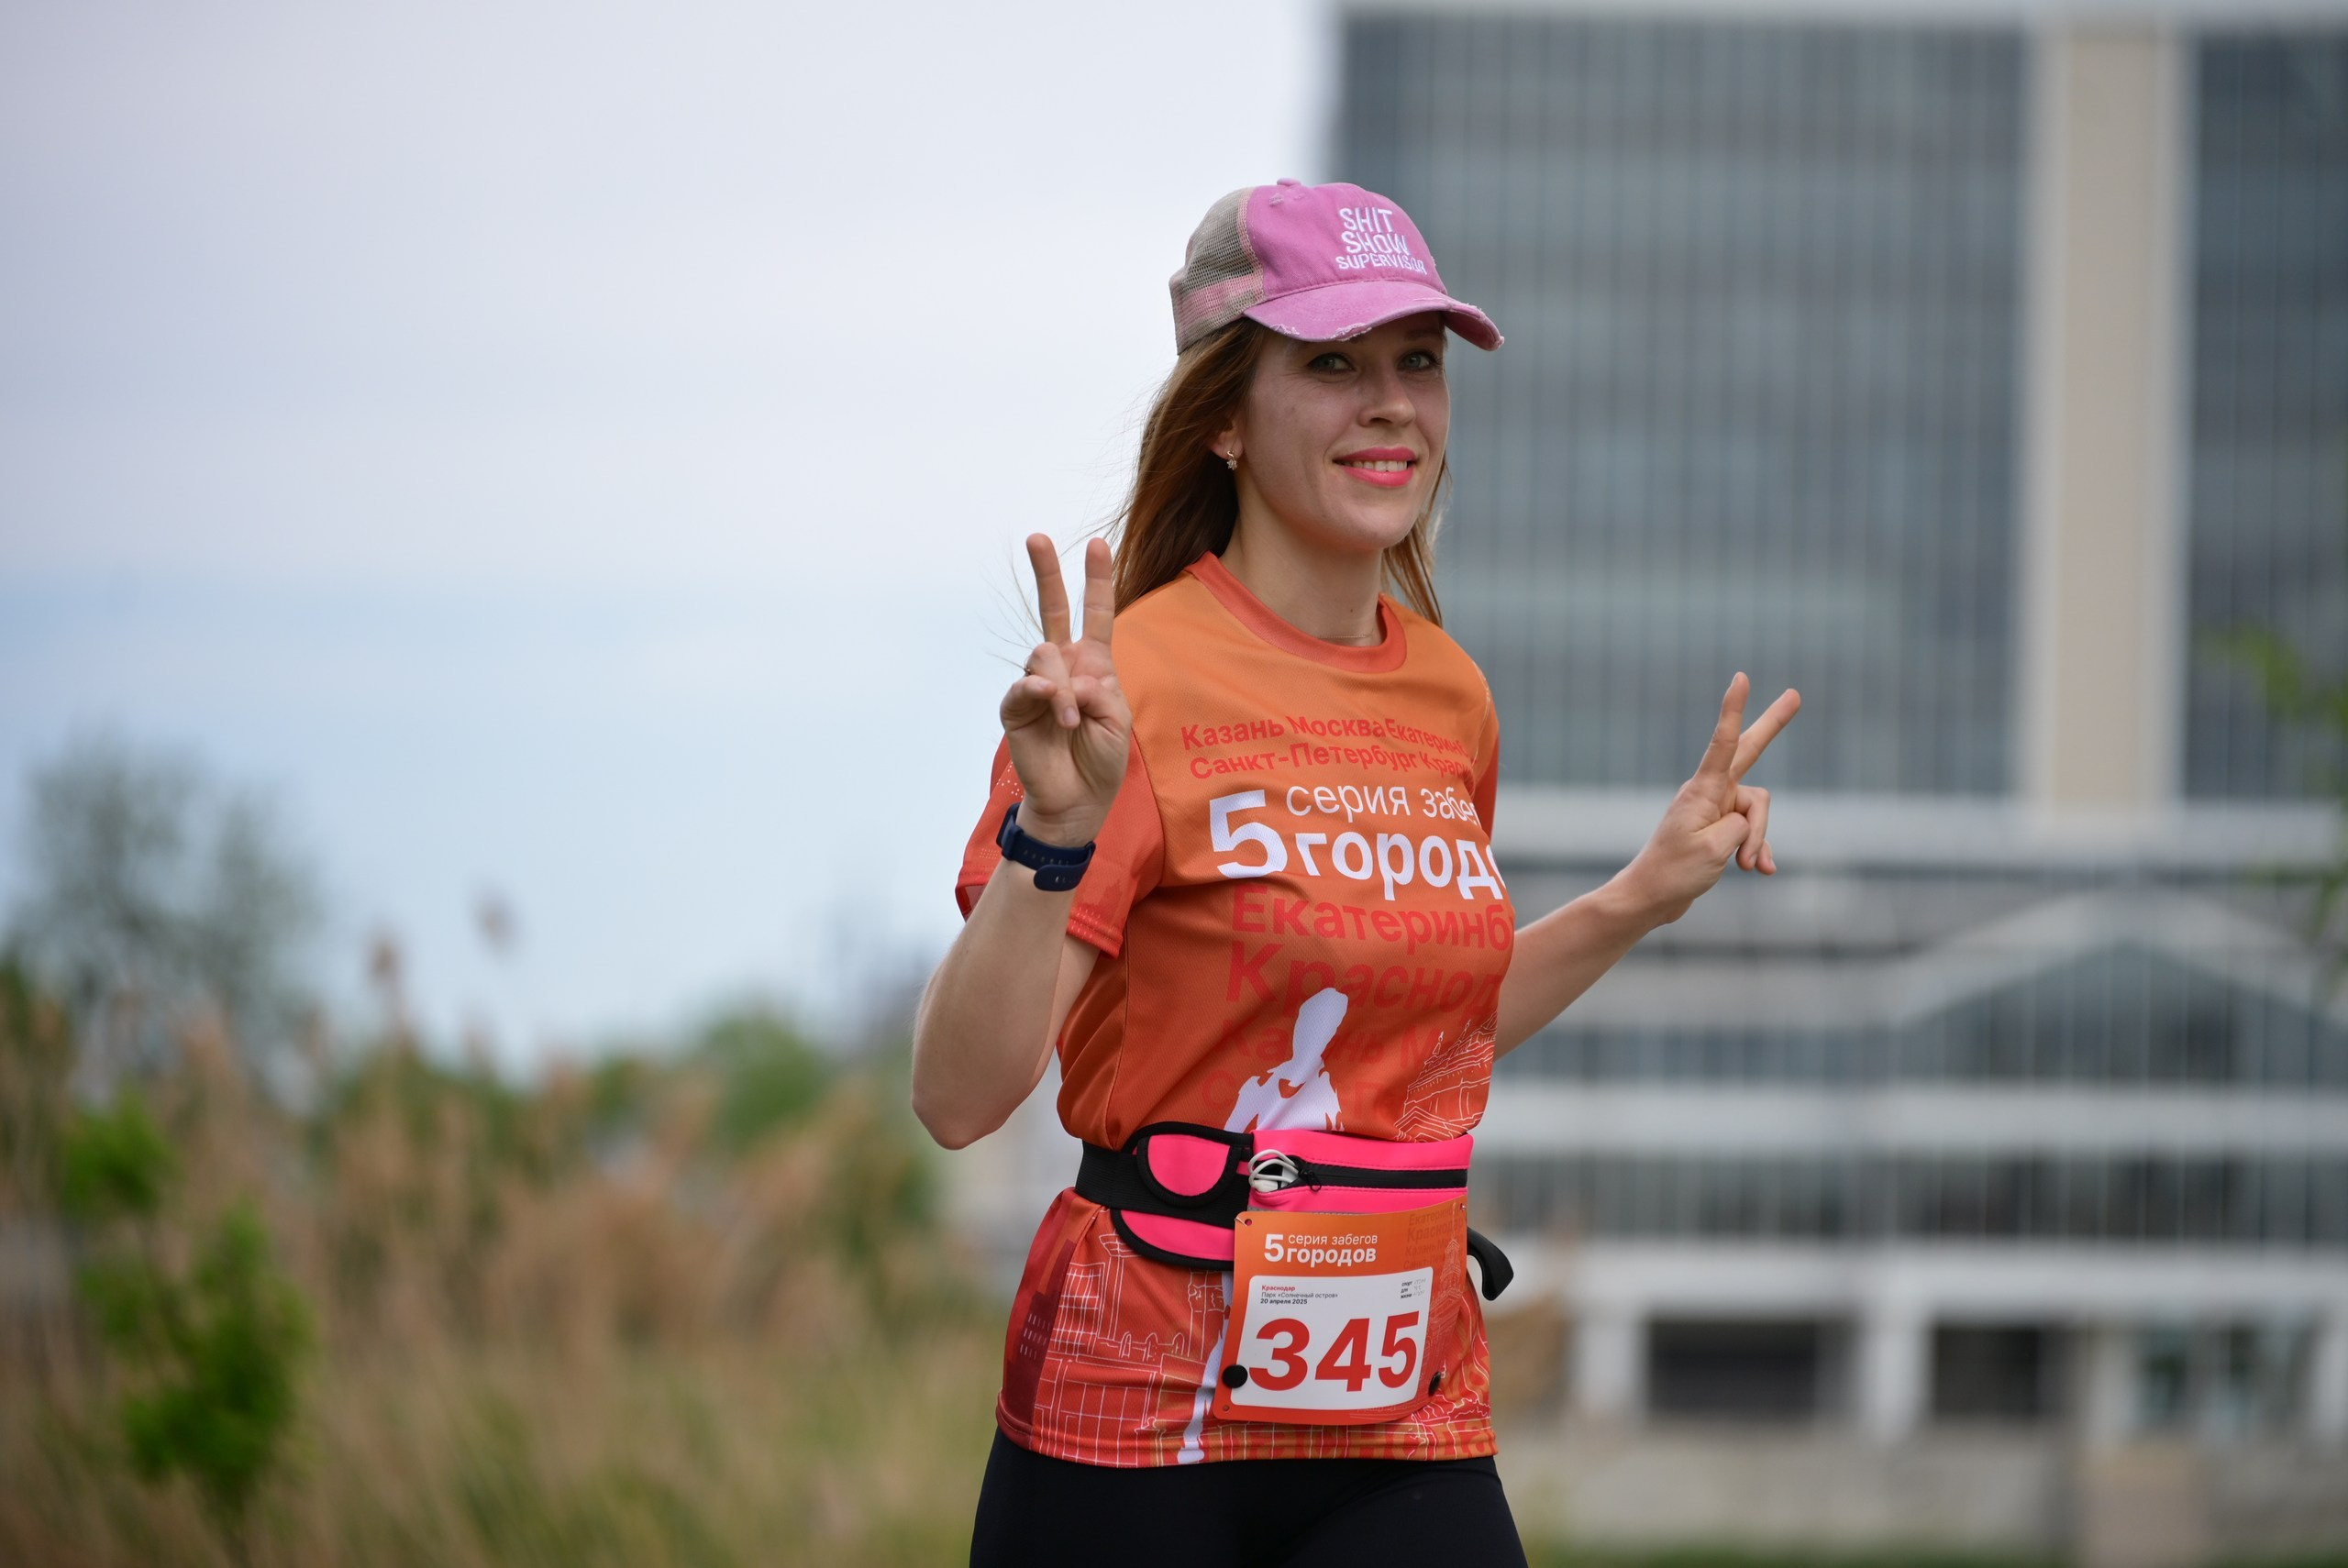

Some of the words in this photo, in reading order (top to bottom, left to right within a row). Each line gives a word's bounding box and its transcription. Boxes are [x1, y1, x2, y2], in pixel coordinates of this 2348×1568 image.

[1339, 207, 1392, 233] SHIT
[1341, 231, 1411, 256] SHOW
[1335, 253, 1427, 275] SUPERVISOR
[1180, 721, 1284, 750] Казань
[1285, 715, 1387, 738] Москва
[1190, 743, 1418, 779] Санкт-Петербург
[1286, 784, 1411, 823] серия
[1209, 789, 1288, 879] 5
[1264, 1233, 1284, 1262] 5
[1287, 1248, 1377, 1268] городов
[1288, 1234, 1328, 1247] серия
[1332, 1233, 1378, 1245] забегов
[1248, 1310, 1420, 1392] 345
